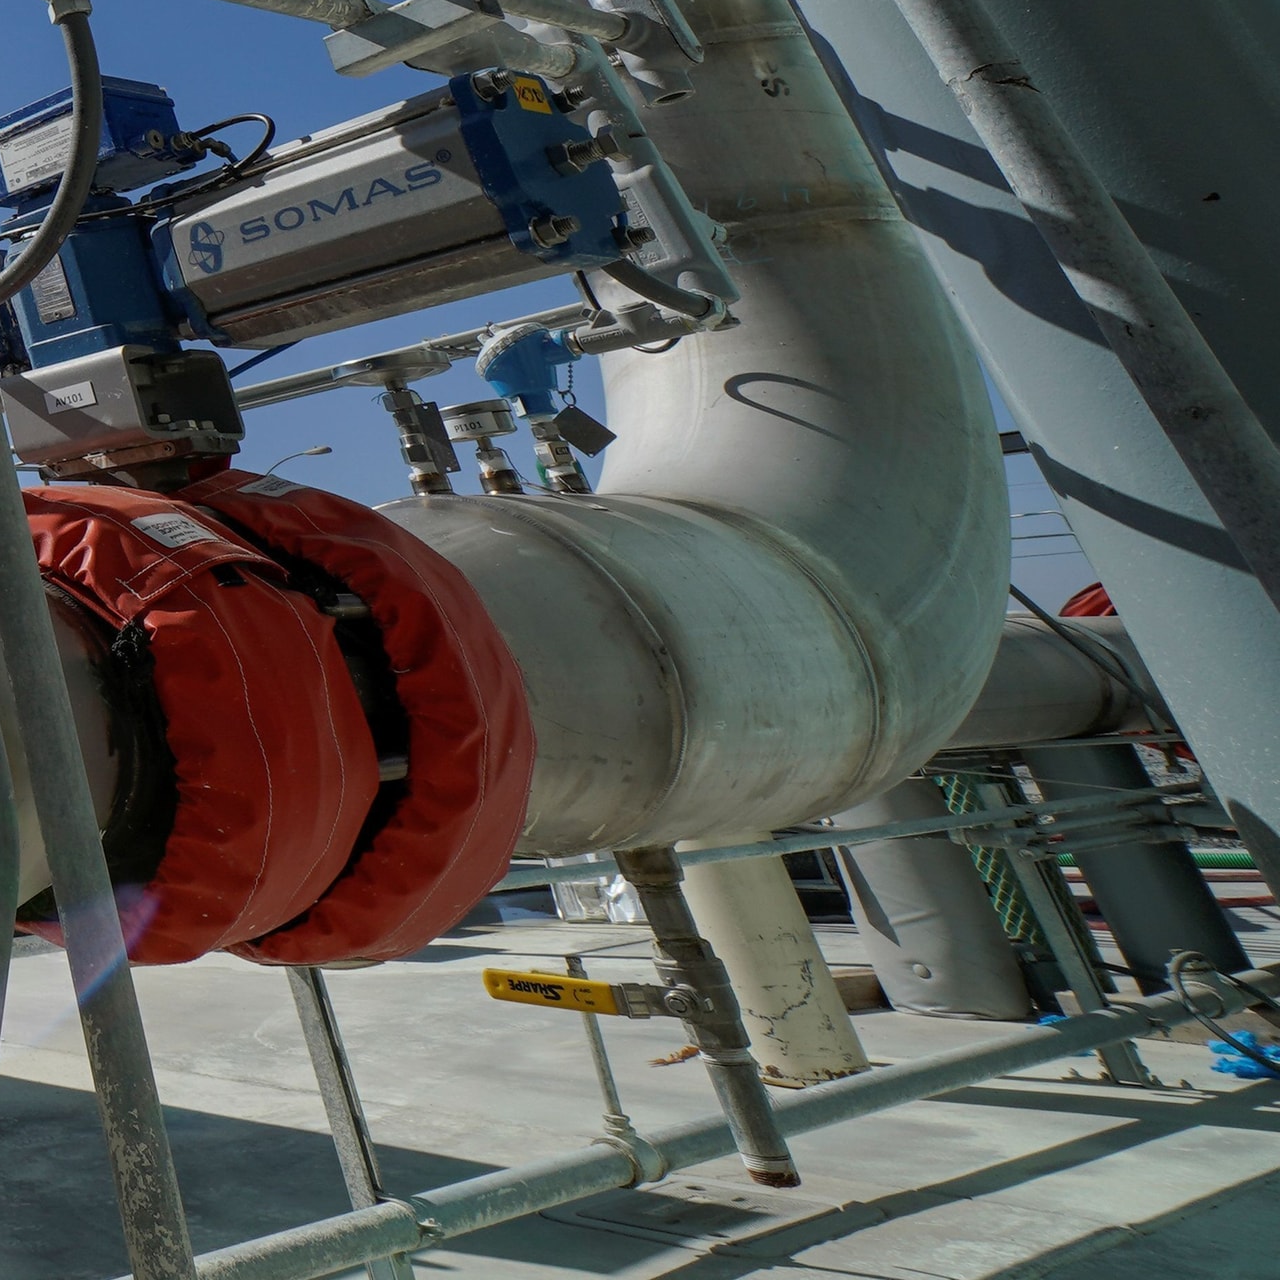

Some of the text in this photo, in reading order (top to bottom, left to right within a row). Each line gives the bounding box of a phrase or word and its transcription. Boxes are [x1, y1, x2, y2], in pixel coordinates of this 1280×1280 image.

[55, 392, 83, 408] AV101
[453, 420, 484, 433] PI101
[506, 978, 565, 1002] SHARPE
